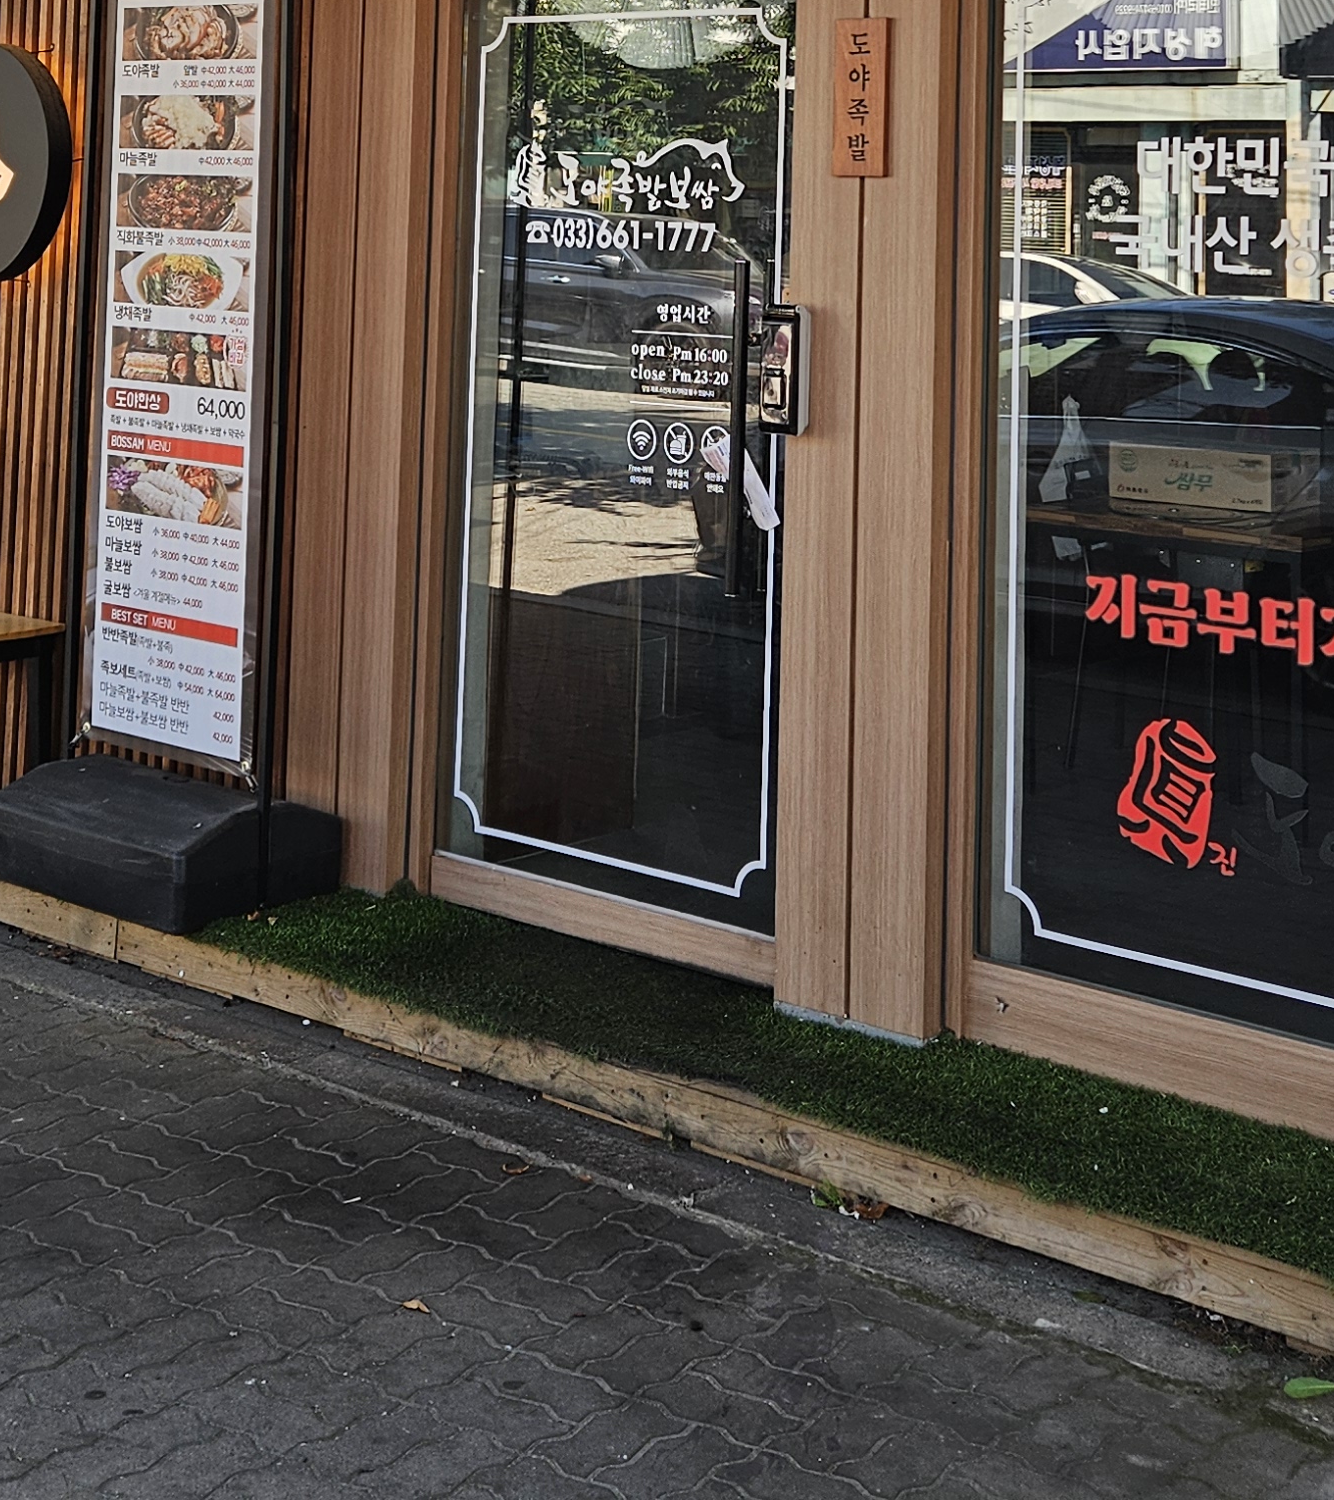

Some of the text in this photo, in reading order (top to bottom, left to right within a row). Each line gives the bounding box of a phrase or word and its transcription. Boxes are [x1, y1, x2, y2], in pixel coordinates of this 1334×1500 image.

[121, 62, 160, 79] 도야족발
[847, 32, 871, 163] 도야족발
[119, 151, 158, 168] 마늘족발
[116, 229, 165, 247] 직화불족발
[551, 217, 716, 253] 033)661-1777
[1108, 213, 1258, 275] 국내산
[114, 305, 153, 323] 냉채족발
[656, 303, 711, 324] 영업시간
[631, 343, 665, 360] open
[630, 363, 667, 381] close
[114, 389, 161, 411] 도야한상
[197, 396, 245, 420] 64,000
[110, 434, 171, 453] BOSSAM MENU
[105, 514, 143, 534] 도야보쌈
[105, 535, 142, 556] 마늘보쌈
[104, 556, 133, 575] 불보쌈
[103, 579, 132, 599] 굴보쌈
[110, 608, 176, 631] BEST SET MENU
[170, 696, 190, 715] 반반
[169, 717, 189, 736] 반반
[1208, 842, 1239, 878] 진
